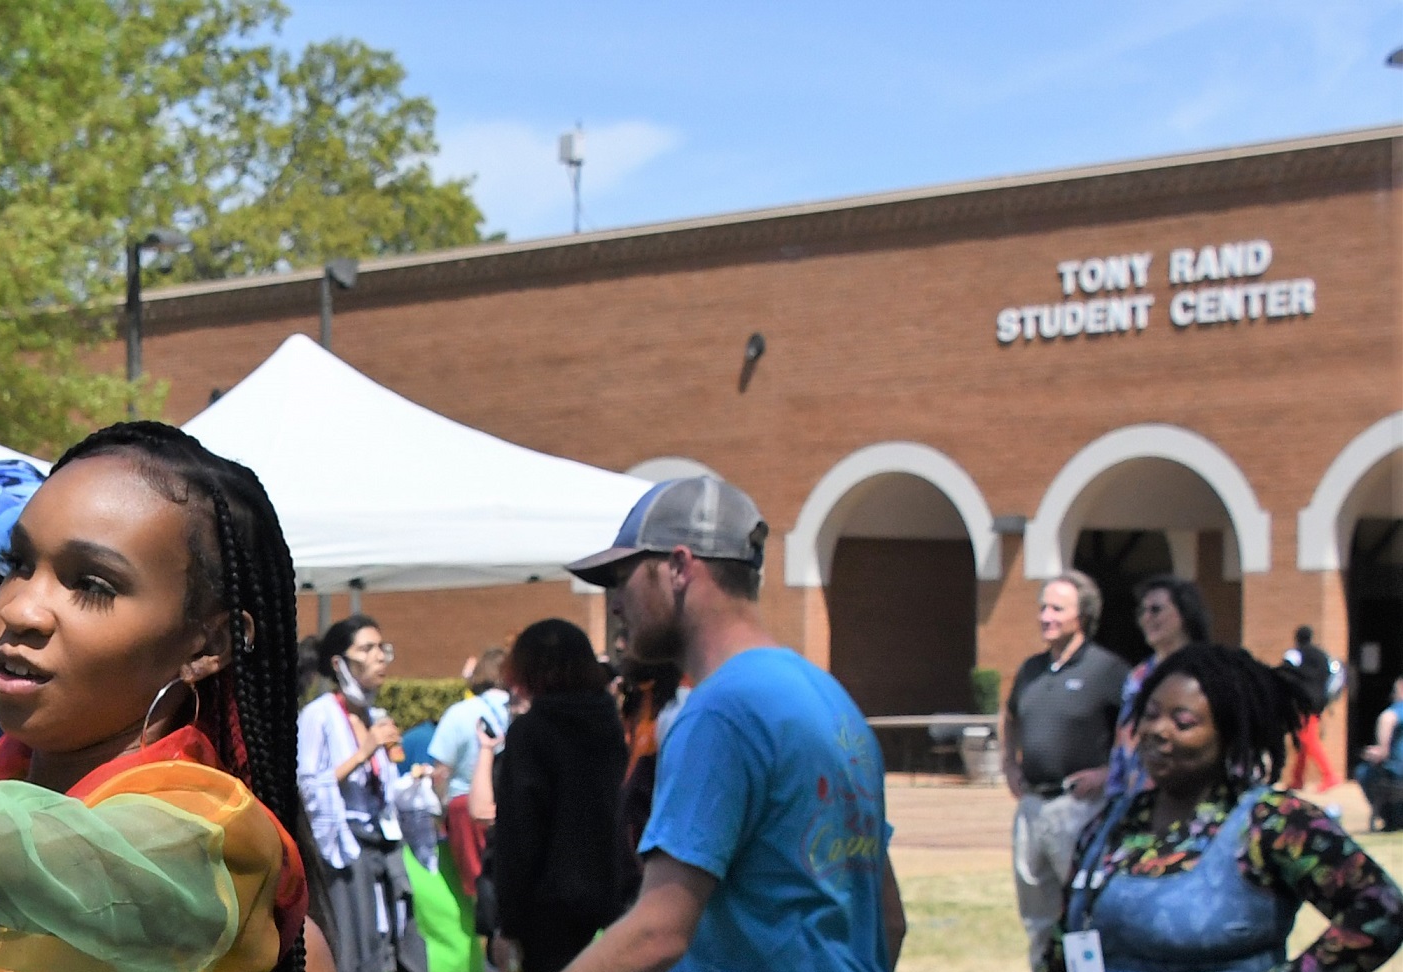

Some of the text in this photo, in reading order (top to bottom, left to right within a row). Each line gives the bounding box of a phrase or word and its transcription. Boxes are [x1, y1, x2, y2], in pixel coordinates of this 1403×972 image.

[1057, 239, 1273, 296] TONY RAND
[996, 277, 1316, 342] STUDENT CENTER
